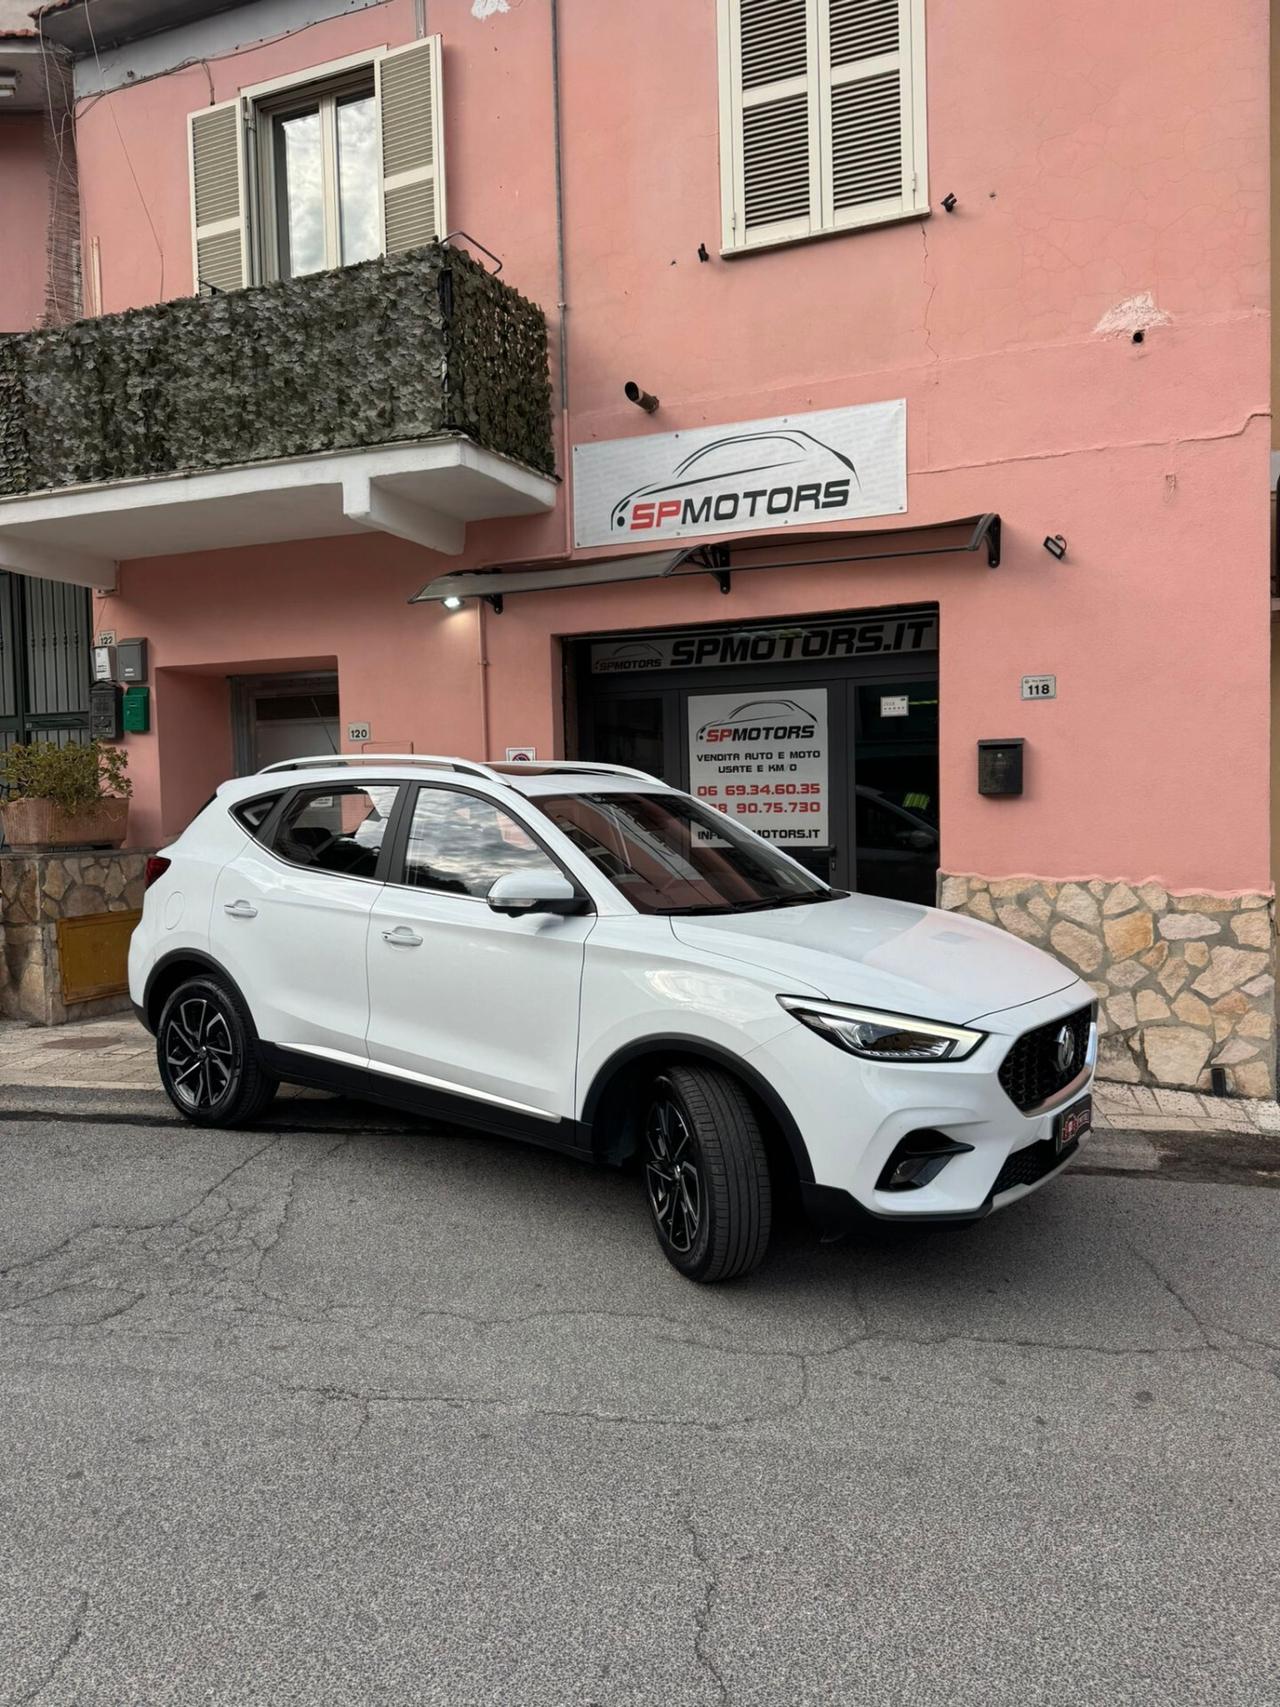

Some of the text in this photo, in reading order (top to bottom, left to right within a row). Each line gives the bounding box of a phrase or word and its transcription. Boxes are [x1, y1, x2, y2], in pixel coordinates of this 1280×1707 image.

[630, 479, 850, 530] SPMOTORS
[101, 636, 113, 645] 122
[670, 620, 933, 666] SPMOTORS.IT
[599, 658, 662, 671] SPMOTORS
[1028, 684, 1050, 695] 118
[351, 729, 368, 738] 120
[706, 725, 815, 742] SPMOTORS
[697, 750, 821, 762] VENDITA AUTO E MOTO
[718, 765, 752, 774] USATE
[757, 764, 763, 773] E
[768, 764, 784, 773] KM
[697, 783, 821, 797] 06 69.34.60.35
[736, 802, 821, 814] 90.75.730
